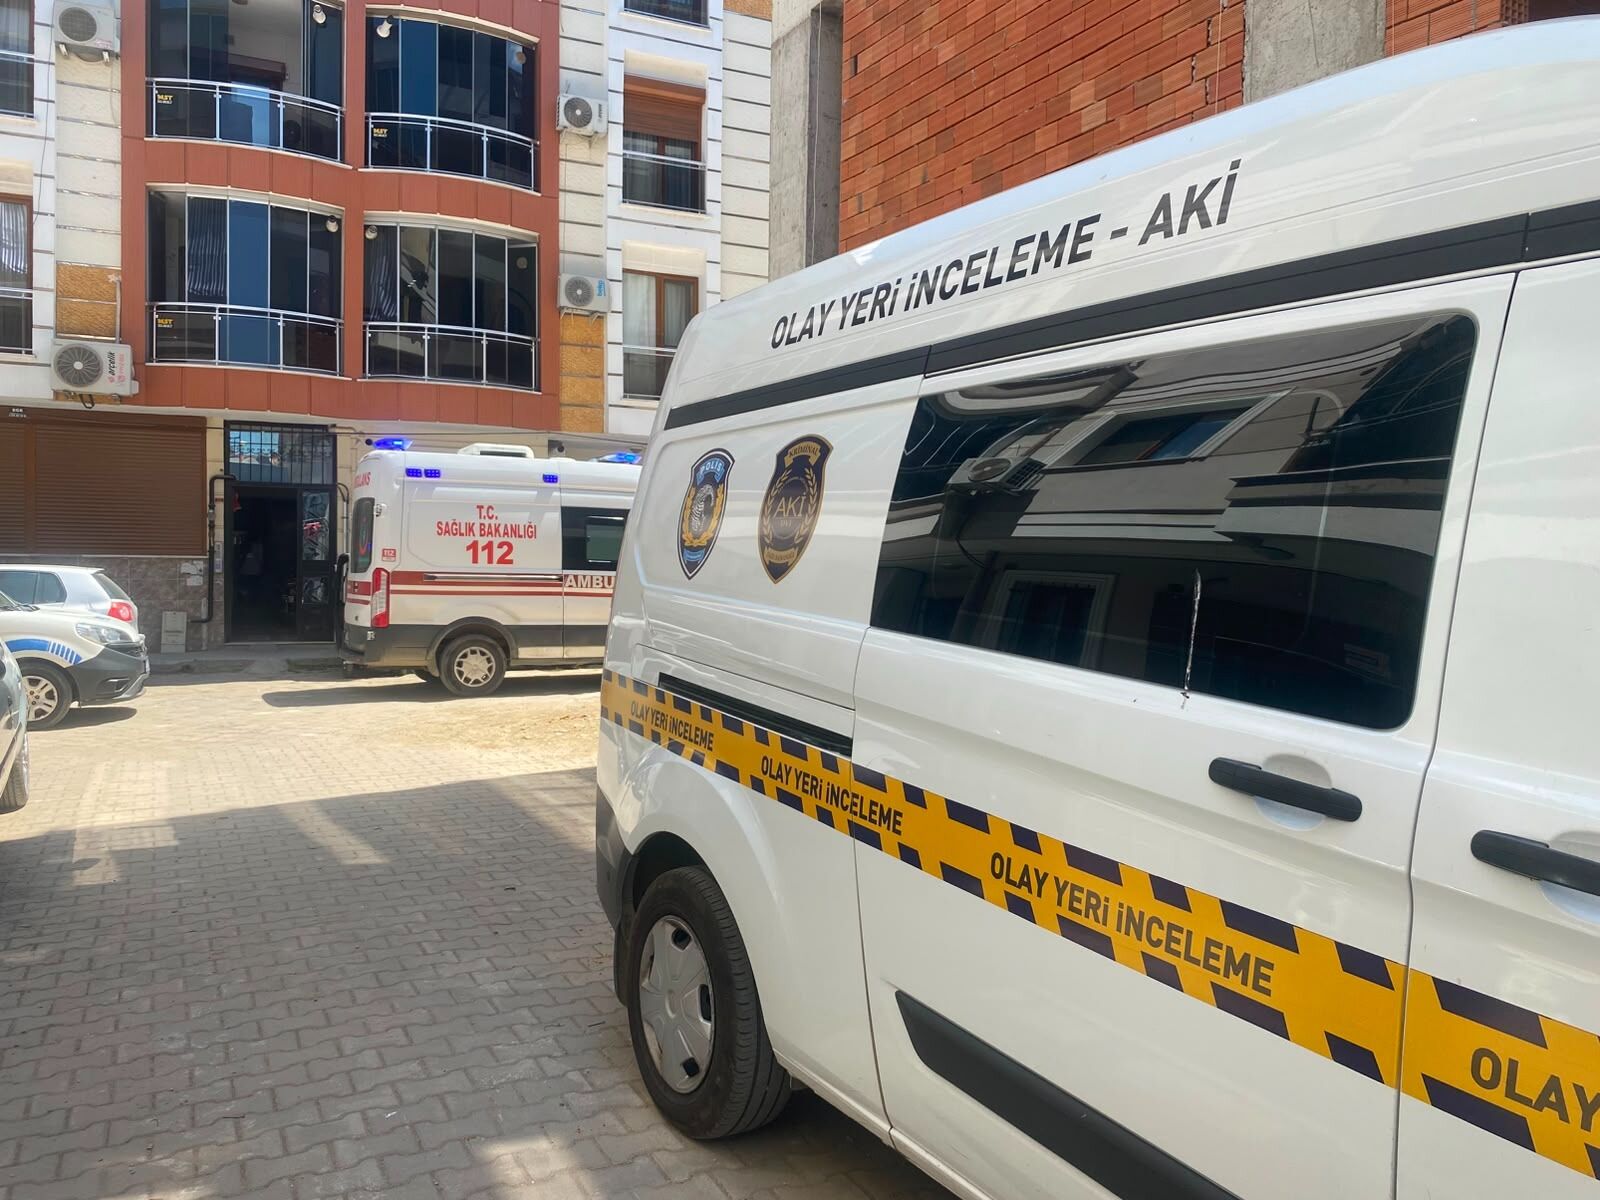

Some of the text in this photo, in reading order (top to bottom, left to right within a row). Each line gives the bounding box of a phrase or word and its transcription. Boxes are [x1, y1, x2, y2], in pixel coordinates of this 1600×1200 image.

[770, 300, 838, 350] OLAY
[1137, 158, 1242, 246] AKİ
[476, 505, 499, 520] T.C.
[436, 519, 537, 539] SAĞLIK BAKANLIĞI
[466, 540, 514, 565] 112
[630, 700, 650, 723] OLAY
[761, 755, 794, 785] OLAY
[990, 852, 1049, 899] OLAY
[1470, 1047, 1600, 1133] OLAY
